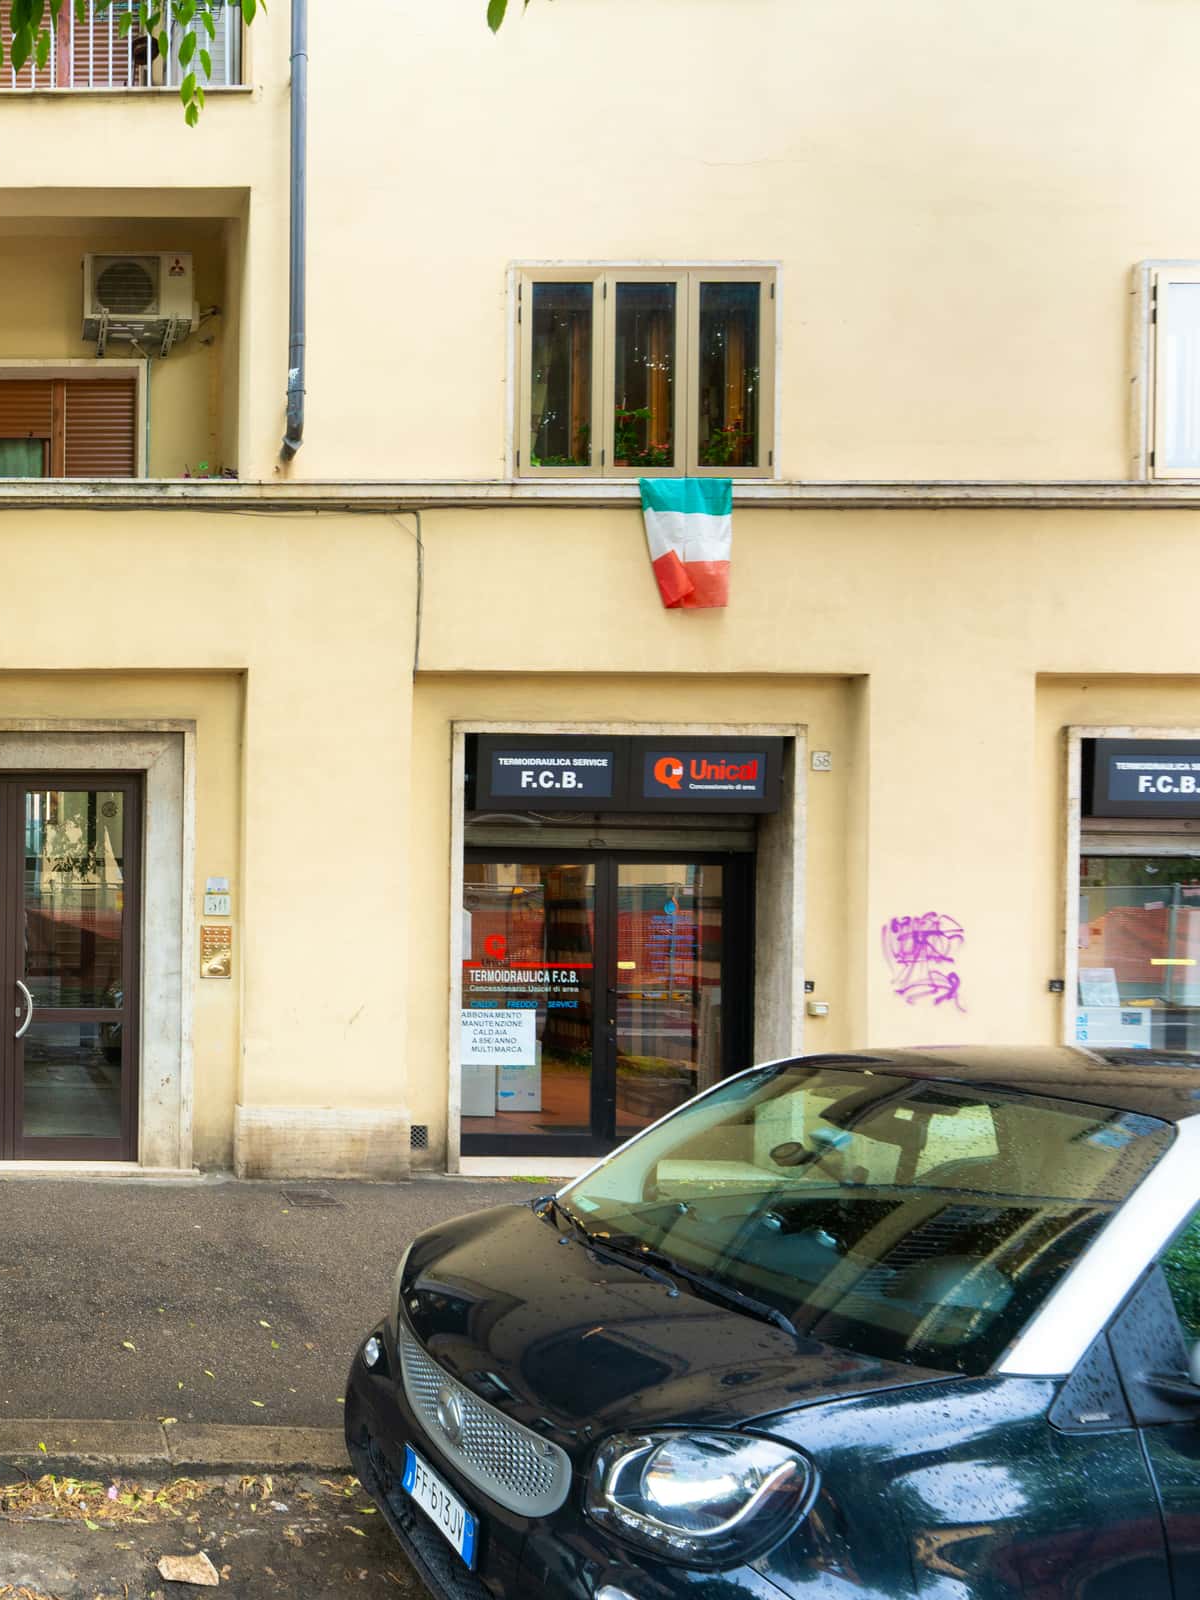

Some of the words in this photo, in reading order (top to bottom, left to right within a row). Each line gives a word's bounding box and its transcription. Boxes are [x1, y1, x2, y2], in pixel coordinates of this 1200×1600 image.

[573, 758, 608, 767] SERVICE
[689, 759, 758, 781] Unical
[521, 770, 583, 788] F.C.B.
[1138, 775, 1200, 793] F.C.B.
[469, 970, 550, 983] TERMOIDRAULICA
[552, 971, 580, 983] F.C.B.
[547, 1001, 579, 1009] SERVICE
[461, 1011, 522, 1019] ABBONAMENTO
